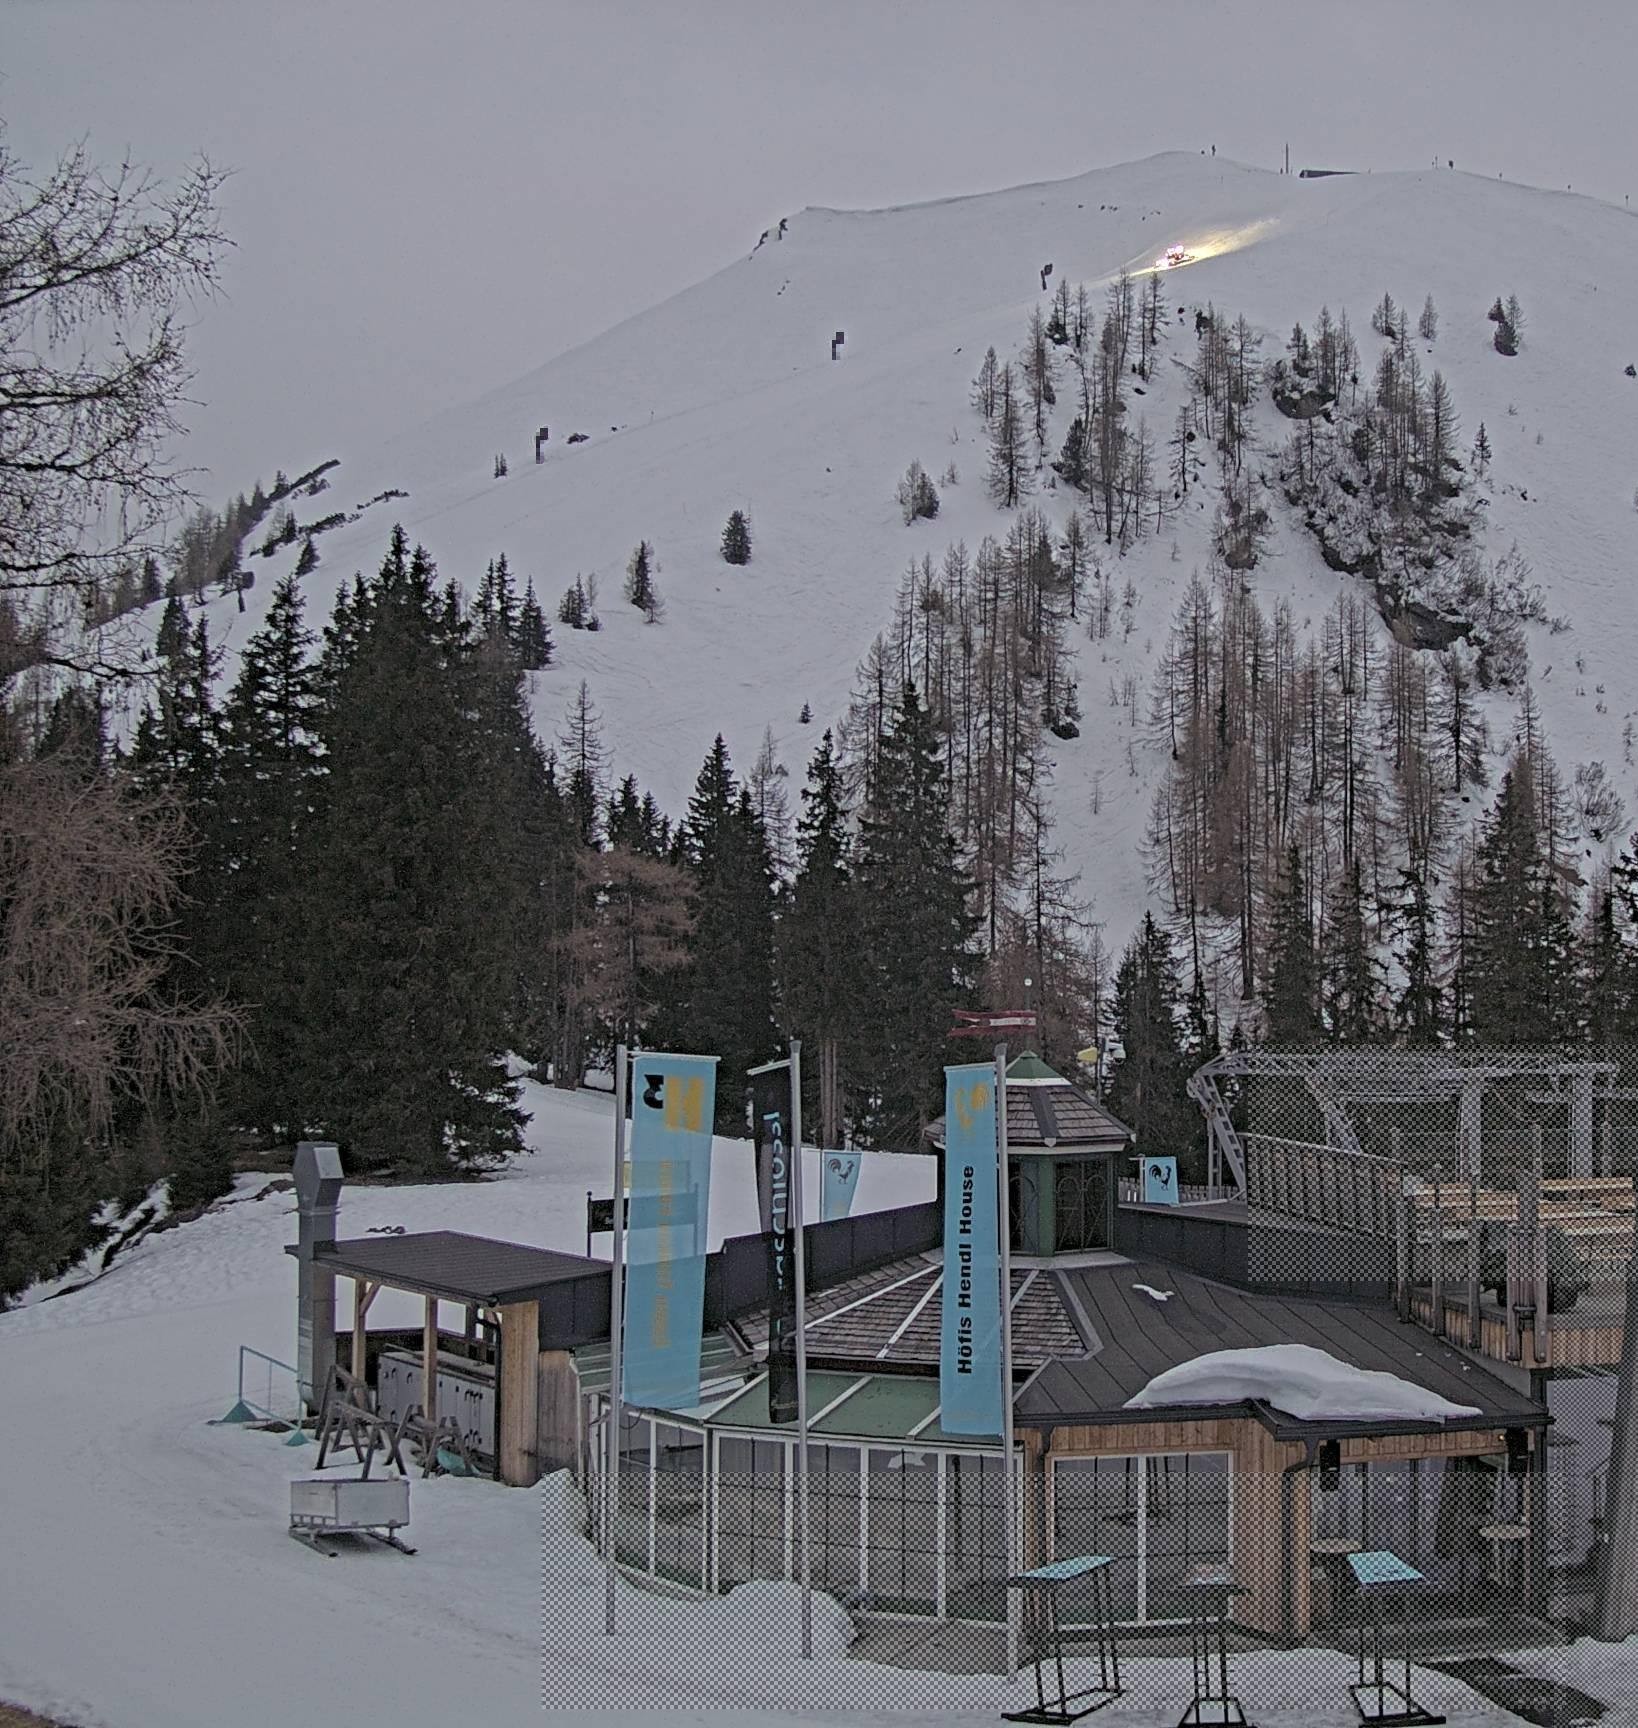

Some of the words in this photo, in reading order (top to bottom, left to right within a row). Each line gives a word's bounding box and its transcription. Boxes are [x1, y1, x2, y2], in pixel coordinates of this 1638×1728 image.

[959, 1165, 974, 1234] House
[958, 1243, 972, 1309] Hendl
[957, 1317, 972, 1374] Höfis
